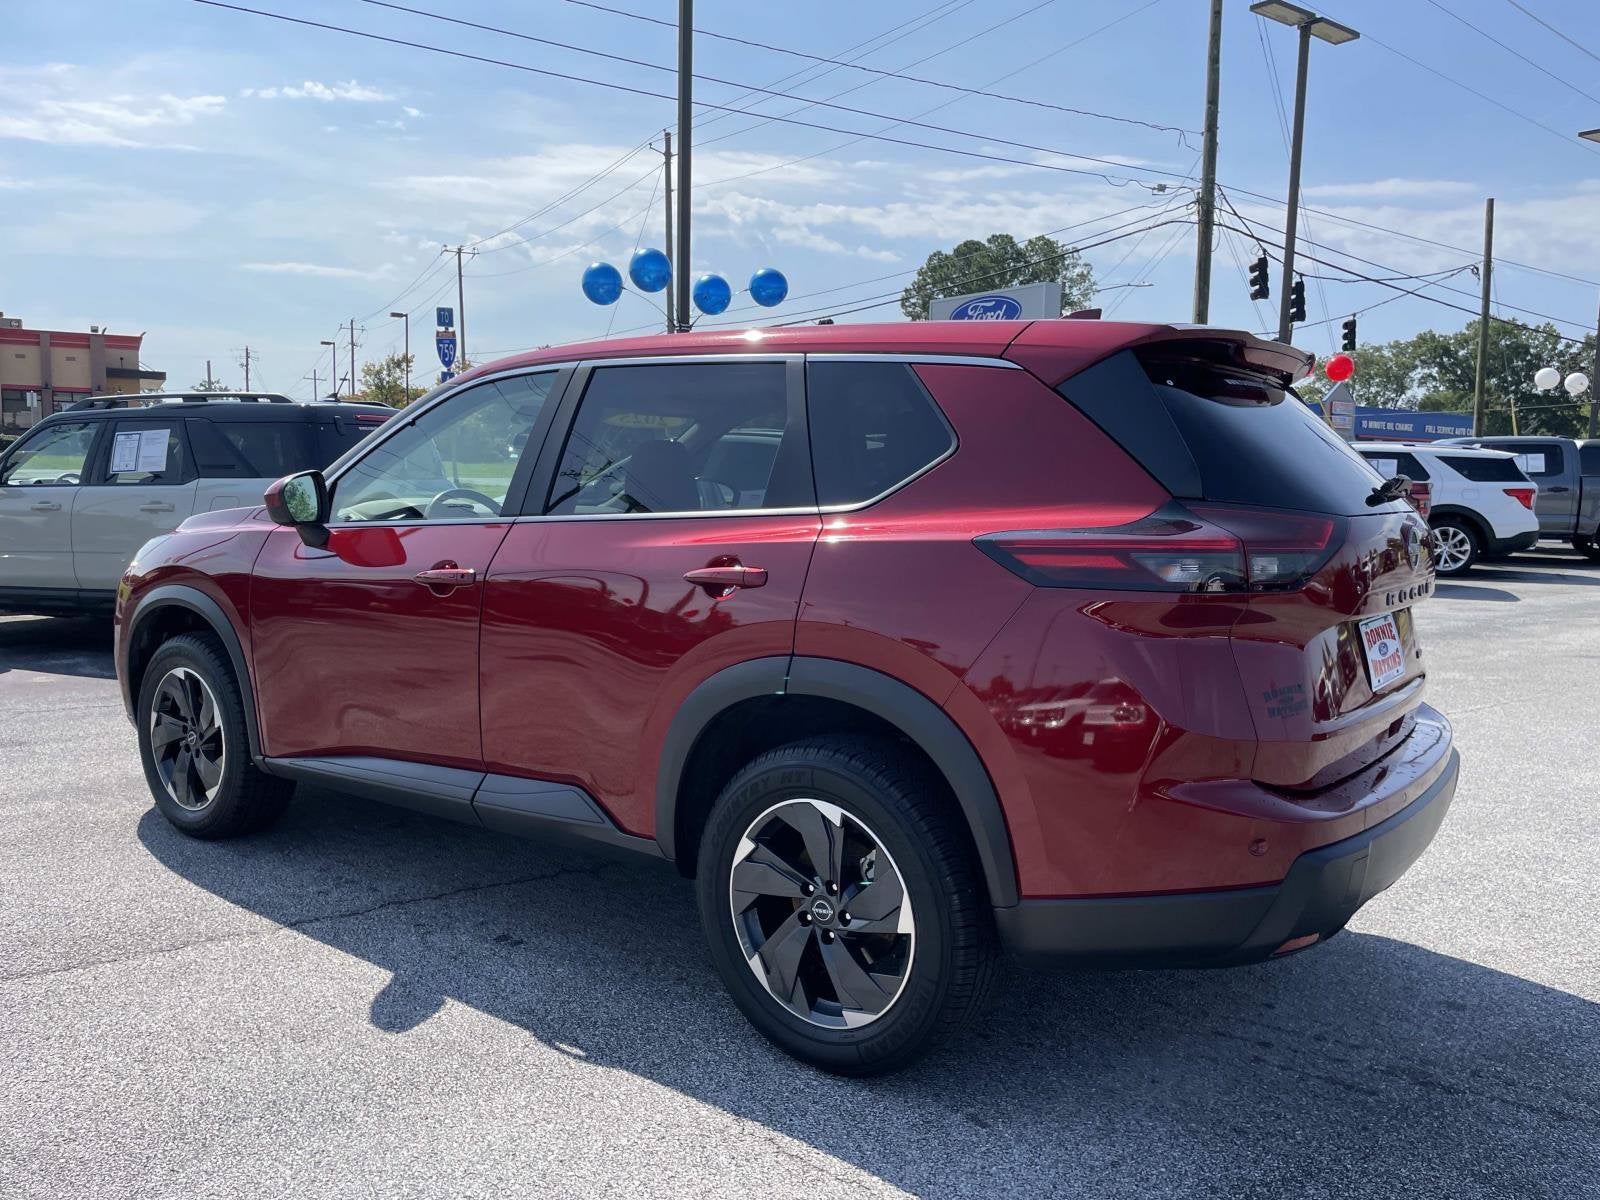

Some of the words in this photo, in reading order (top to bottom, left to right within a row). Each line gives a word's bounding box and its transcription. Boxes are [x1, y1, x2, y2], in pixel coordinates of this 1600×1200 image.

[440, 311, 449, 323] TO
[965, 301, 1007, 320] Ford
[439, 343, 454, 362] 759
[1368, 420, 1386, 430] MINUTE
[1386, 422, 1394, 431] OIL
[1395, 423, 1413, 432] CHANGE
[1425, 425, 1435, 433] FULL
[1436, 425, 1454, 435] SERVICE
[1455, 427, 1466, 435] AUTO
[1364, 622, 1396, 648] RONNIE
[1371, 647, 1402, 678] WATKINS
